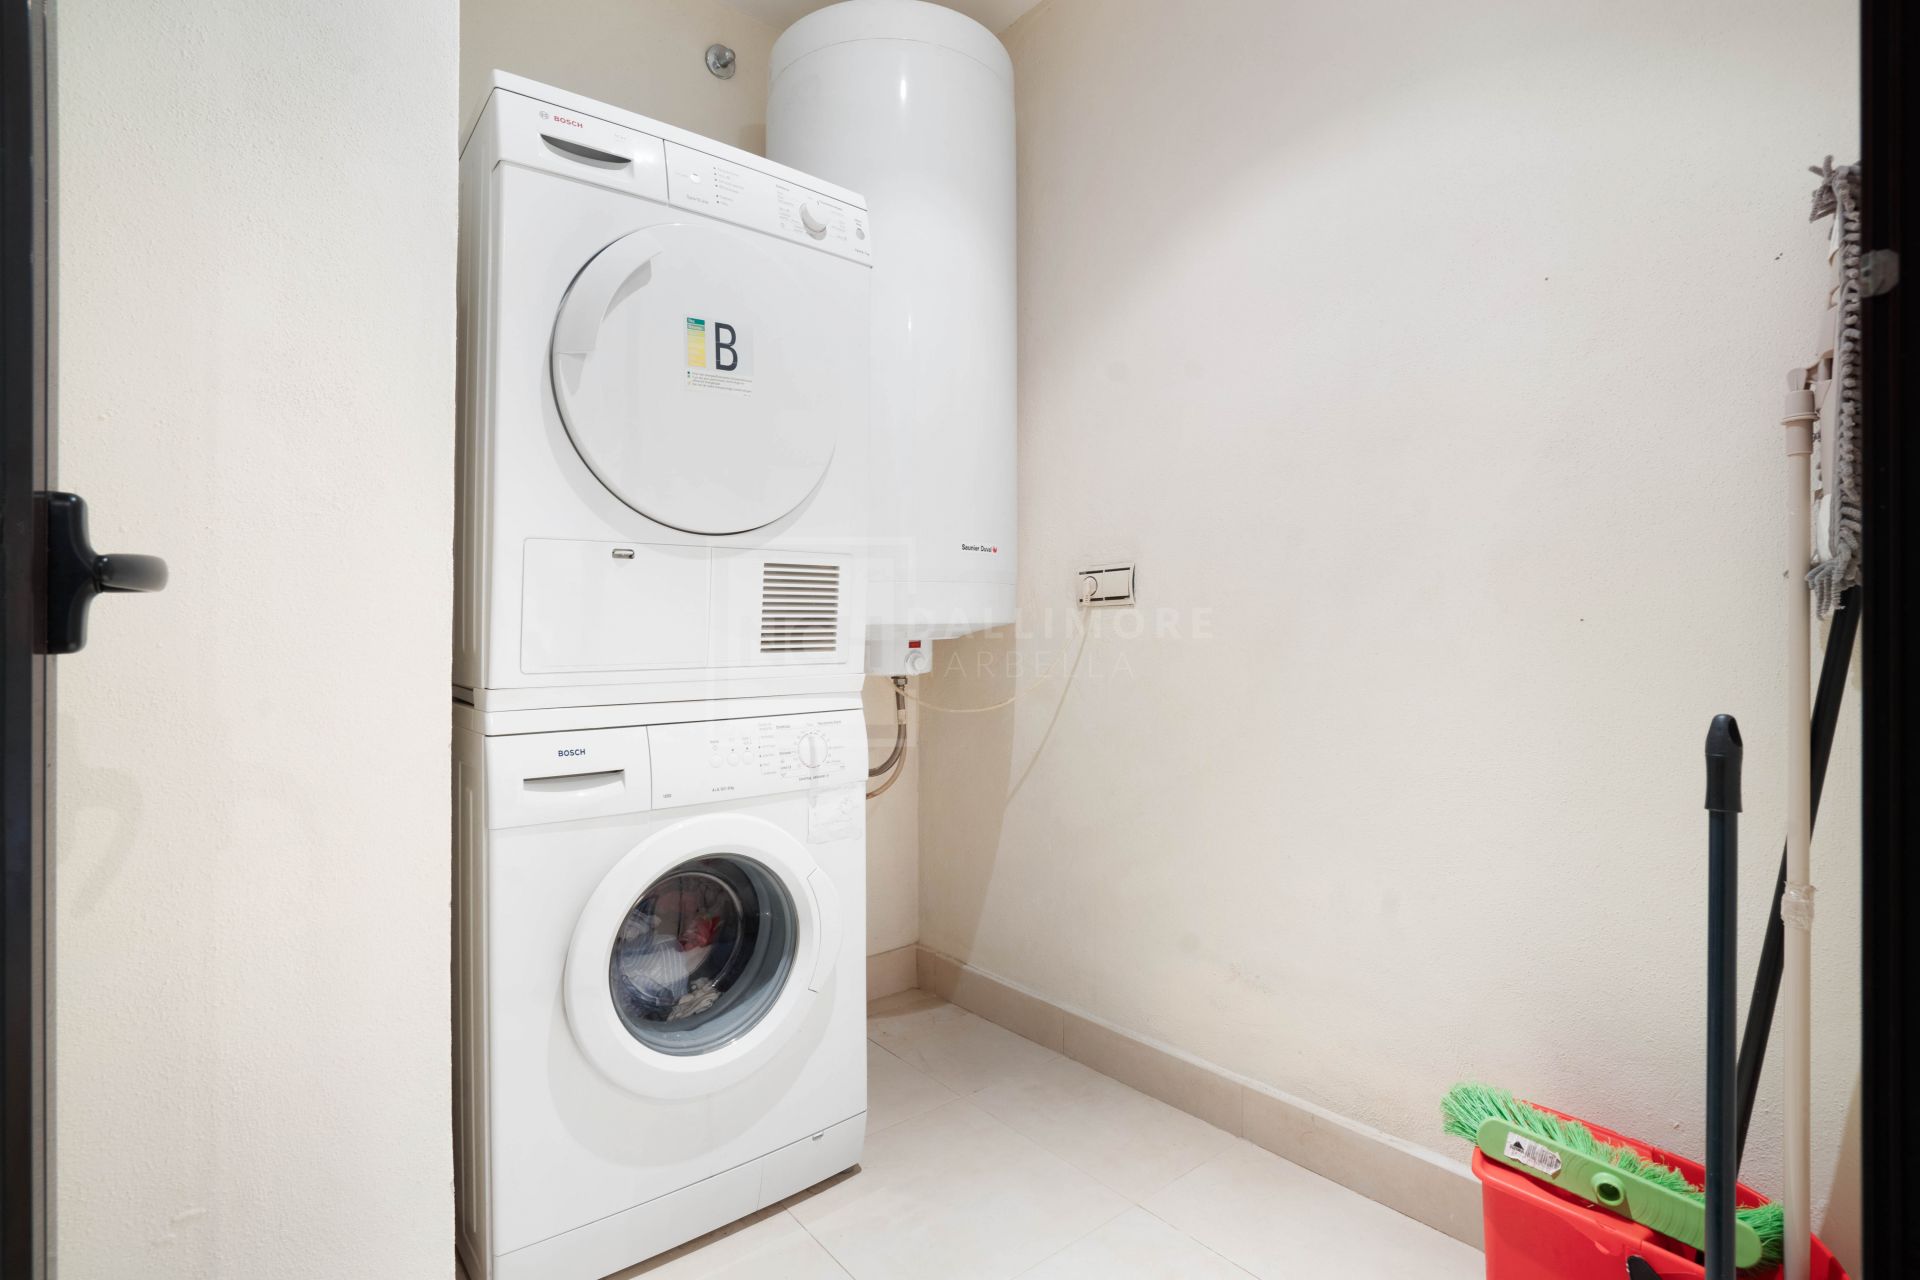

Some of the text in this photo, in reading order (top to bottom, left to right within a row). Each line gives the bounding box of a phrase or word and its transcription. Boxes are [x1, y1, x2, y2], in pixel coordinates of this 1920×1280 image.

[553, 115, 583, 129] BOSCH
[714, 321, 738, 371] B
[558, 748, 586, 757] BOSCH
